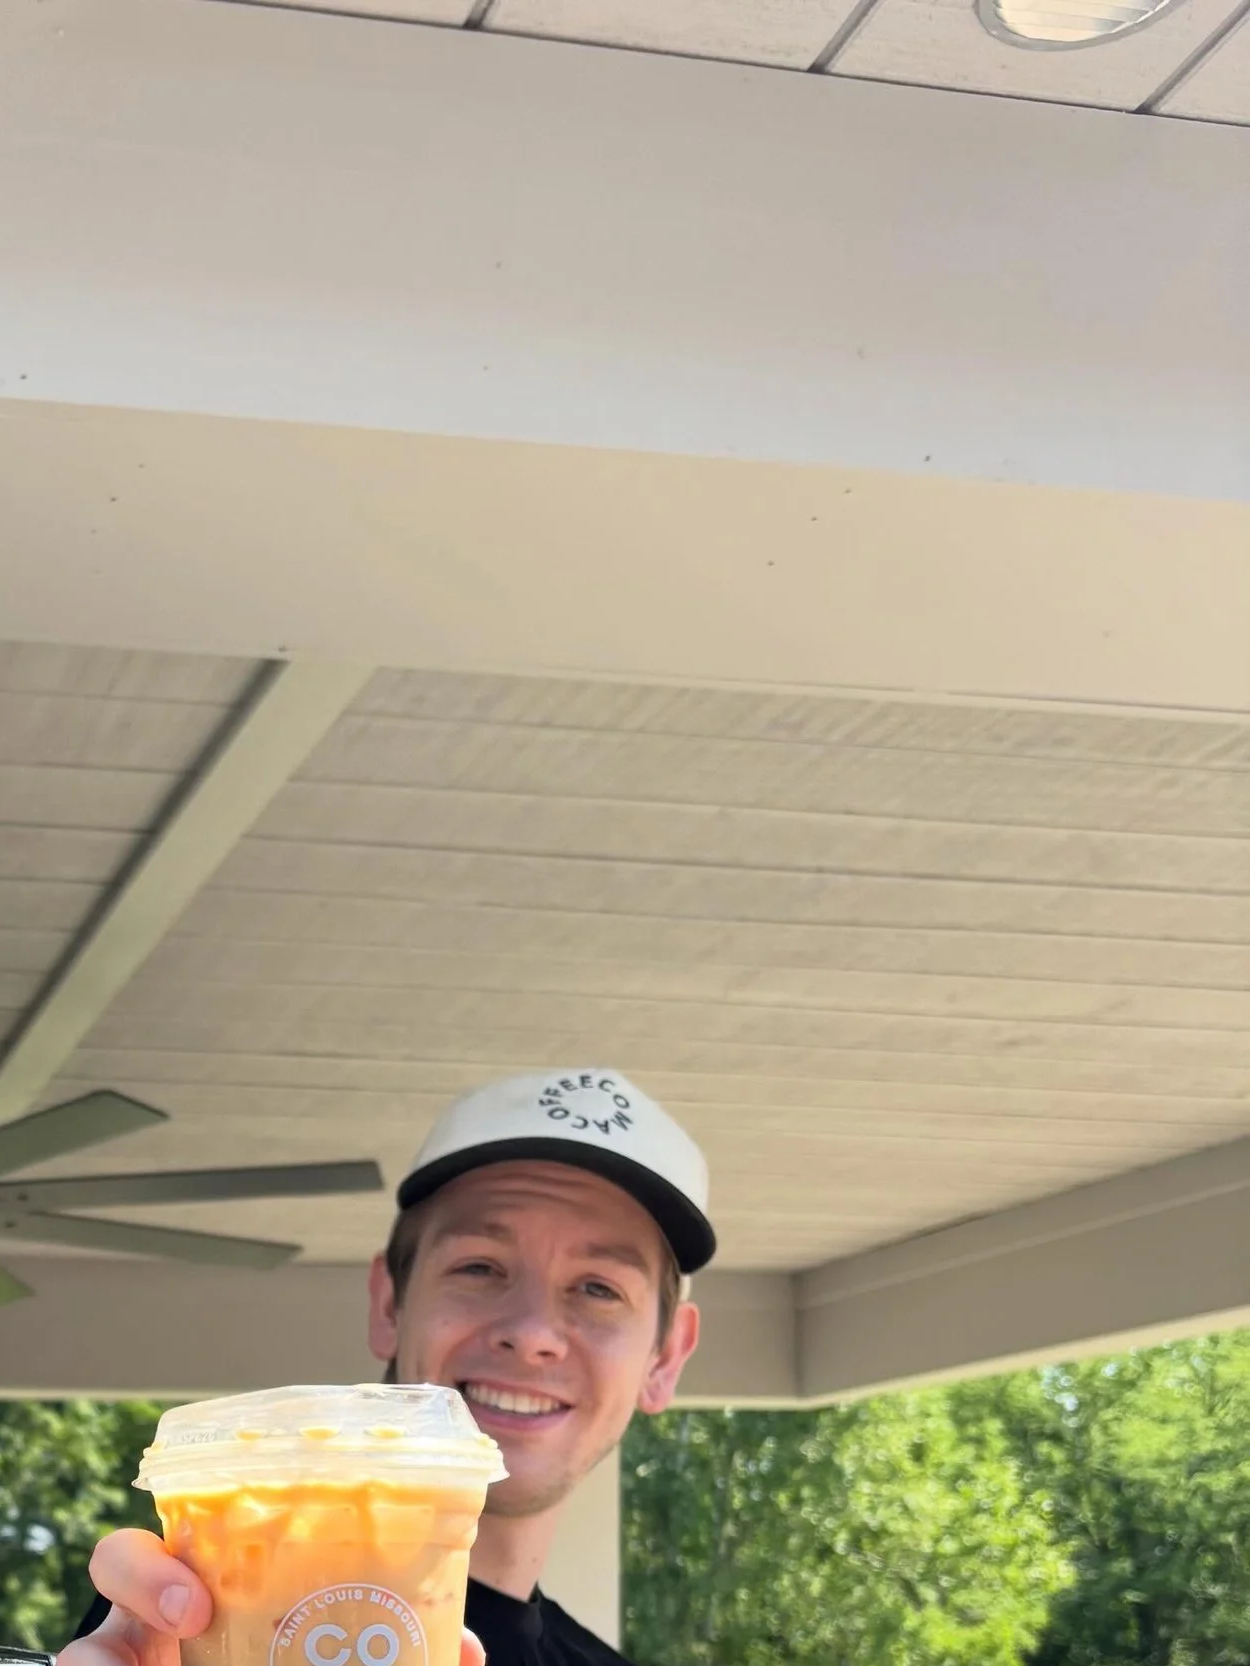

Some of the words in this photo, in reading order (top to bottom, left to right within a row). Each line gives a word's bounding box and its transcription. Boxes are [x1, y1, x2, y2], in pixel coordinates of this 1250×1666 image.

[280, 1606, 311, 1647] SAINT
[313, 1588, 363, 1609] LOUIS
[369, 1590, 422, 1647] MISSOURI
